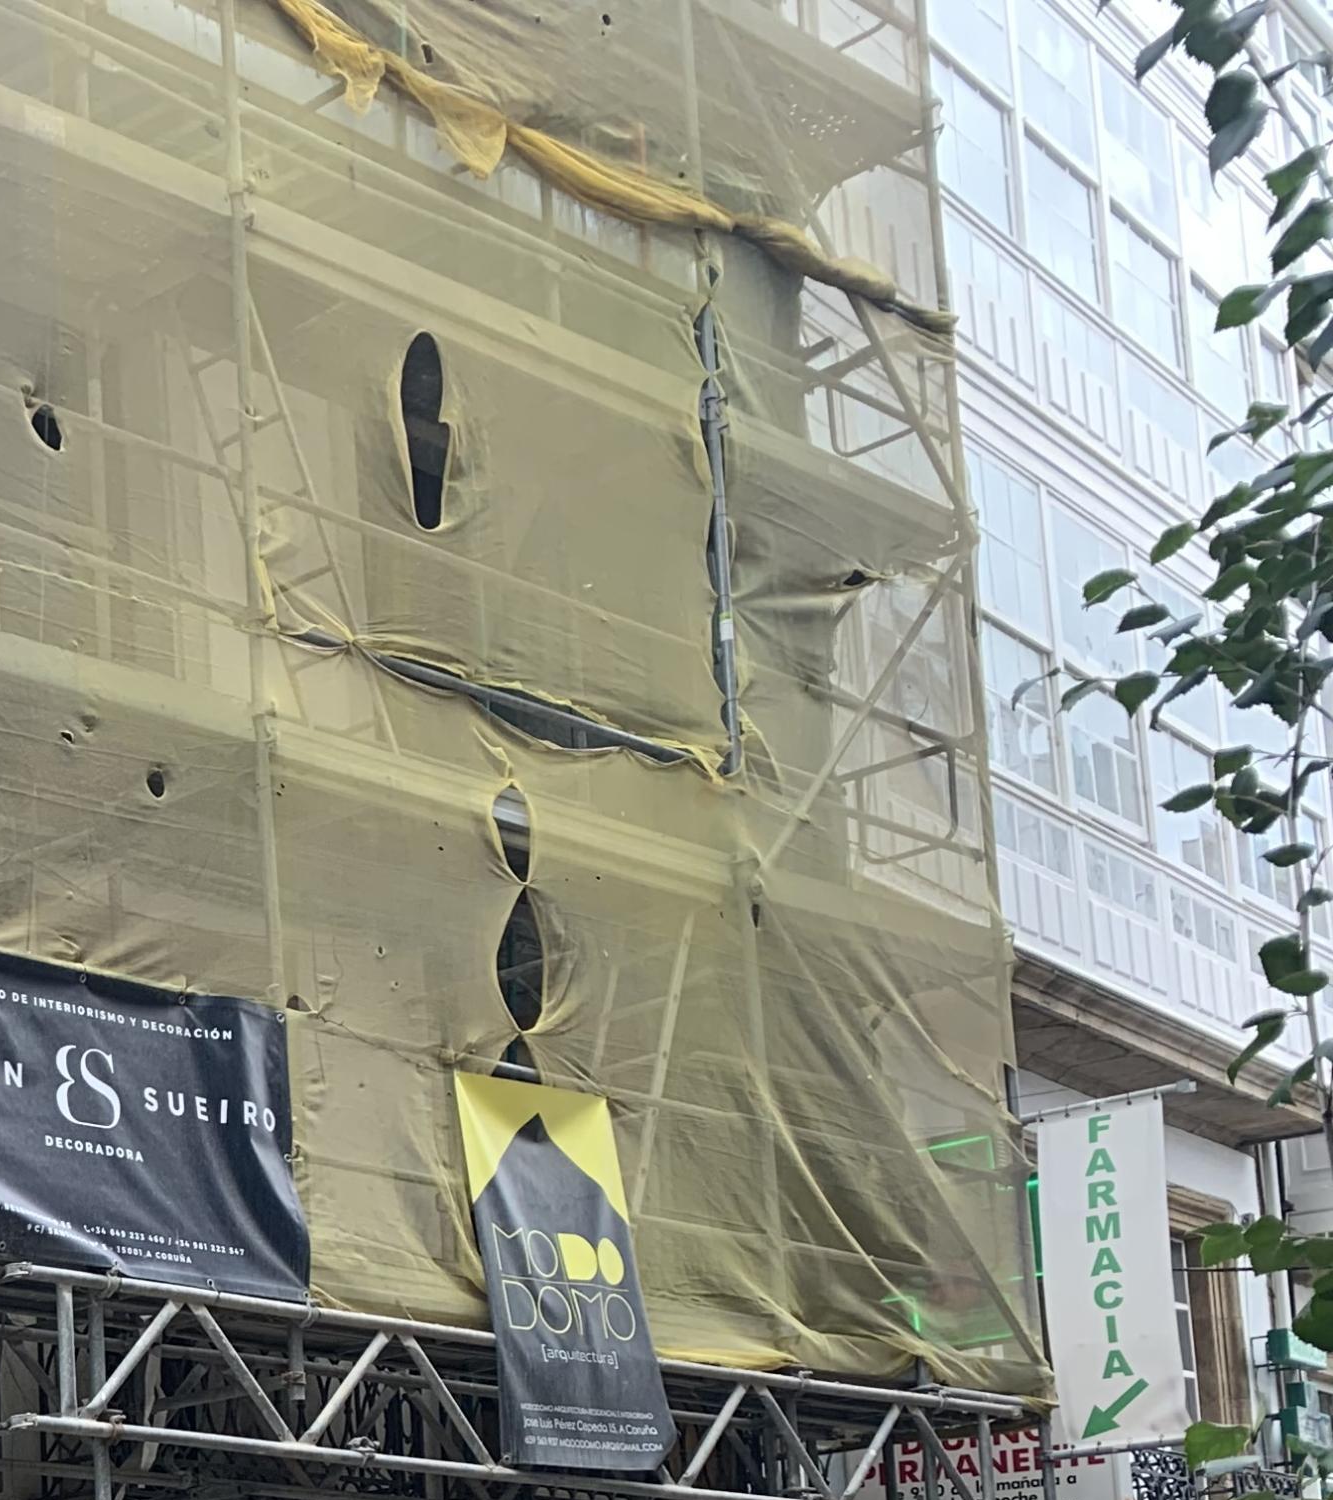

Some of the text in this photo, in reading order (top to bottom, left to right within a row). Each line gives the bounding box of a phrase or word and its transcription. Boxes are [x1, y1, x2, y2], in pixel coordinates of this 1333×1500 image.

[12, 991, 28, 1005] DE
[33, 996, 125, 1025] INTERIORISMO
[130, 1016, 137, 1027] Y
[142, 1020, 233, 1040] DECORACIÓN
[143, 1086, 276, 1133] SUEIRO
[45, 1135, 144, 1163] DECORADORA
[155, 1251, 193, 1264] CORUÑA
[491, 1221, 625, 1286] MODO
[1085, 1113, 1134, 1380] FARMACIA
[502, 1279, 636, 1341] DOMO
[541, 1343, 619, 1370] [arquitectura]
